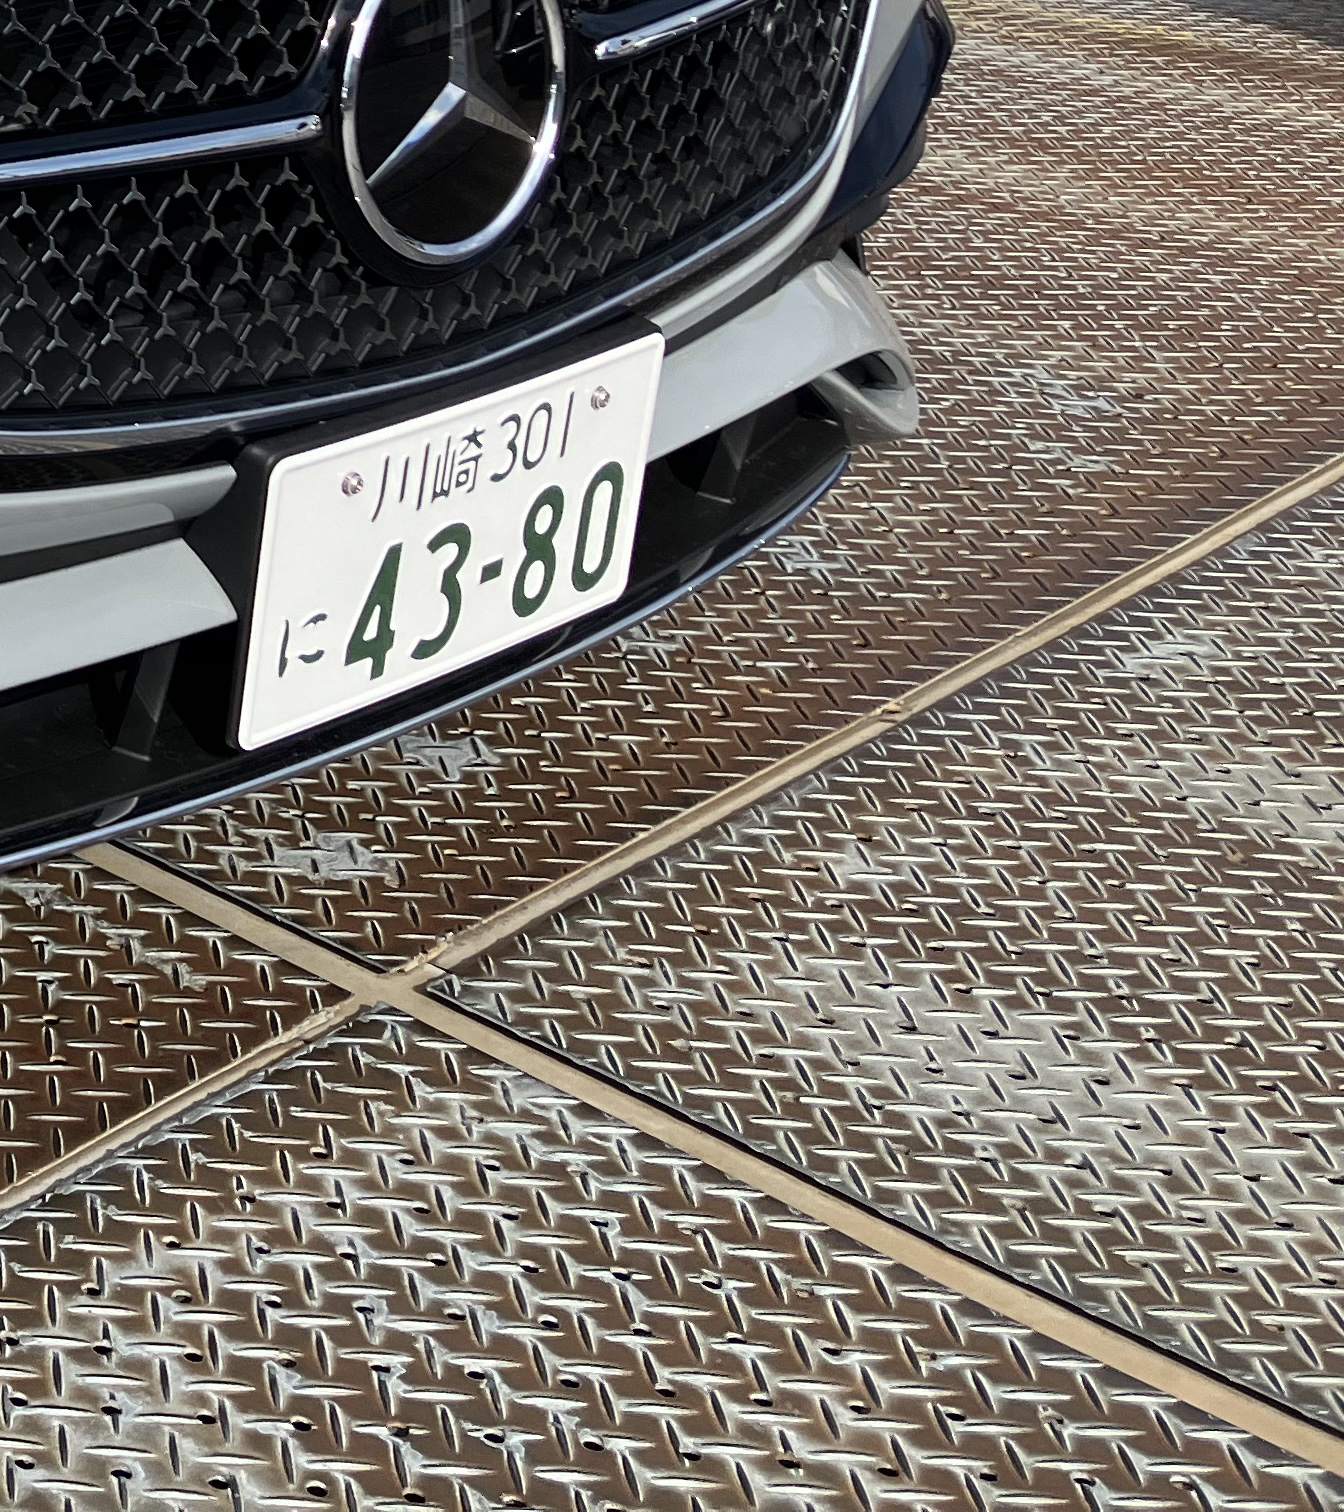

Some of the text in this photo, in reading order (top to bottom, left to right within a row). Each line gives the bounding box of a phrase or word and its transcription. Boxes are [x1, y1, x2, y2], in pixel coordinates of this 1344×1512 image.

[372, 391, 575, 522] 川崎 301
[279, 461, 624, 681] に 43-80
